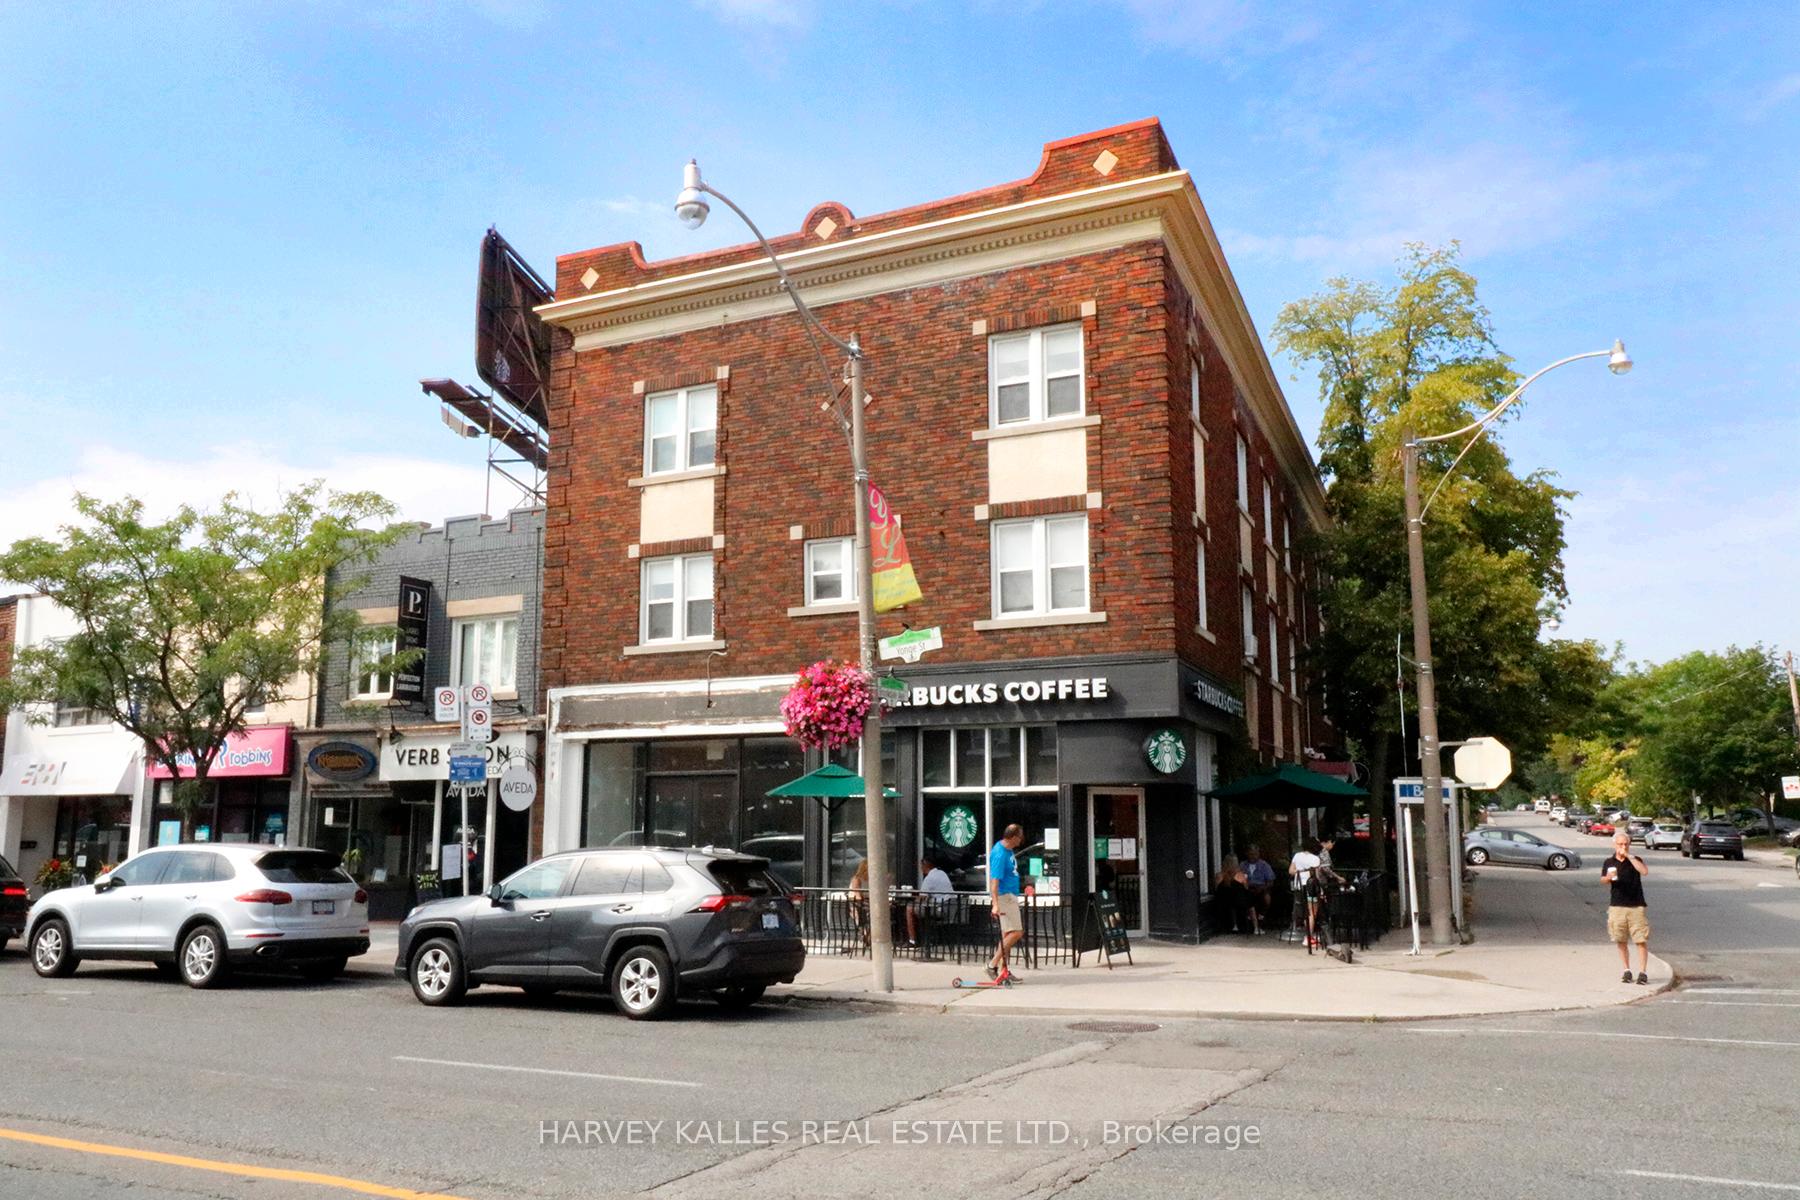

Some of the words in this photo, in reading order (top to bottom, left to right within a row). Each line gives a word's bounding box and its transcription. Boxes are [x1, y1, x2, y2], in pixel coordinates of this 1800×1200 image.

[1003, 677, 1108, 702] COFFEE
[396, 748, 440, 766] VERB
[446, 785, 487, 798] AVDA
[502, 781, 534, 794] AVEDA
